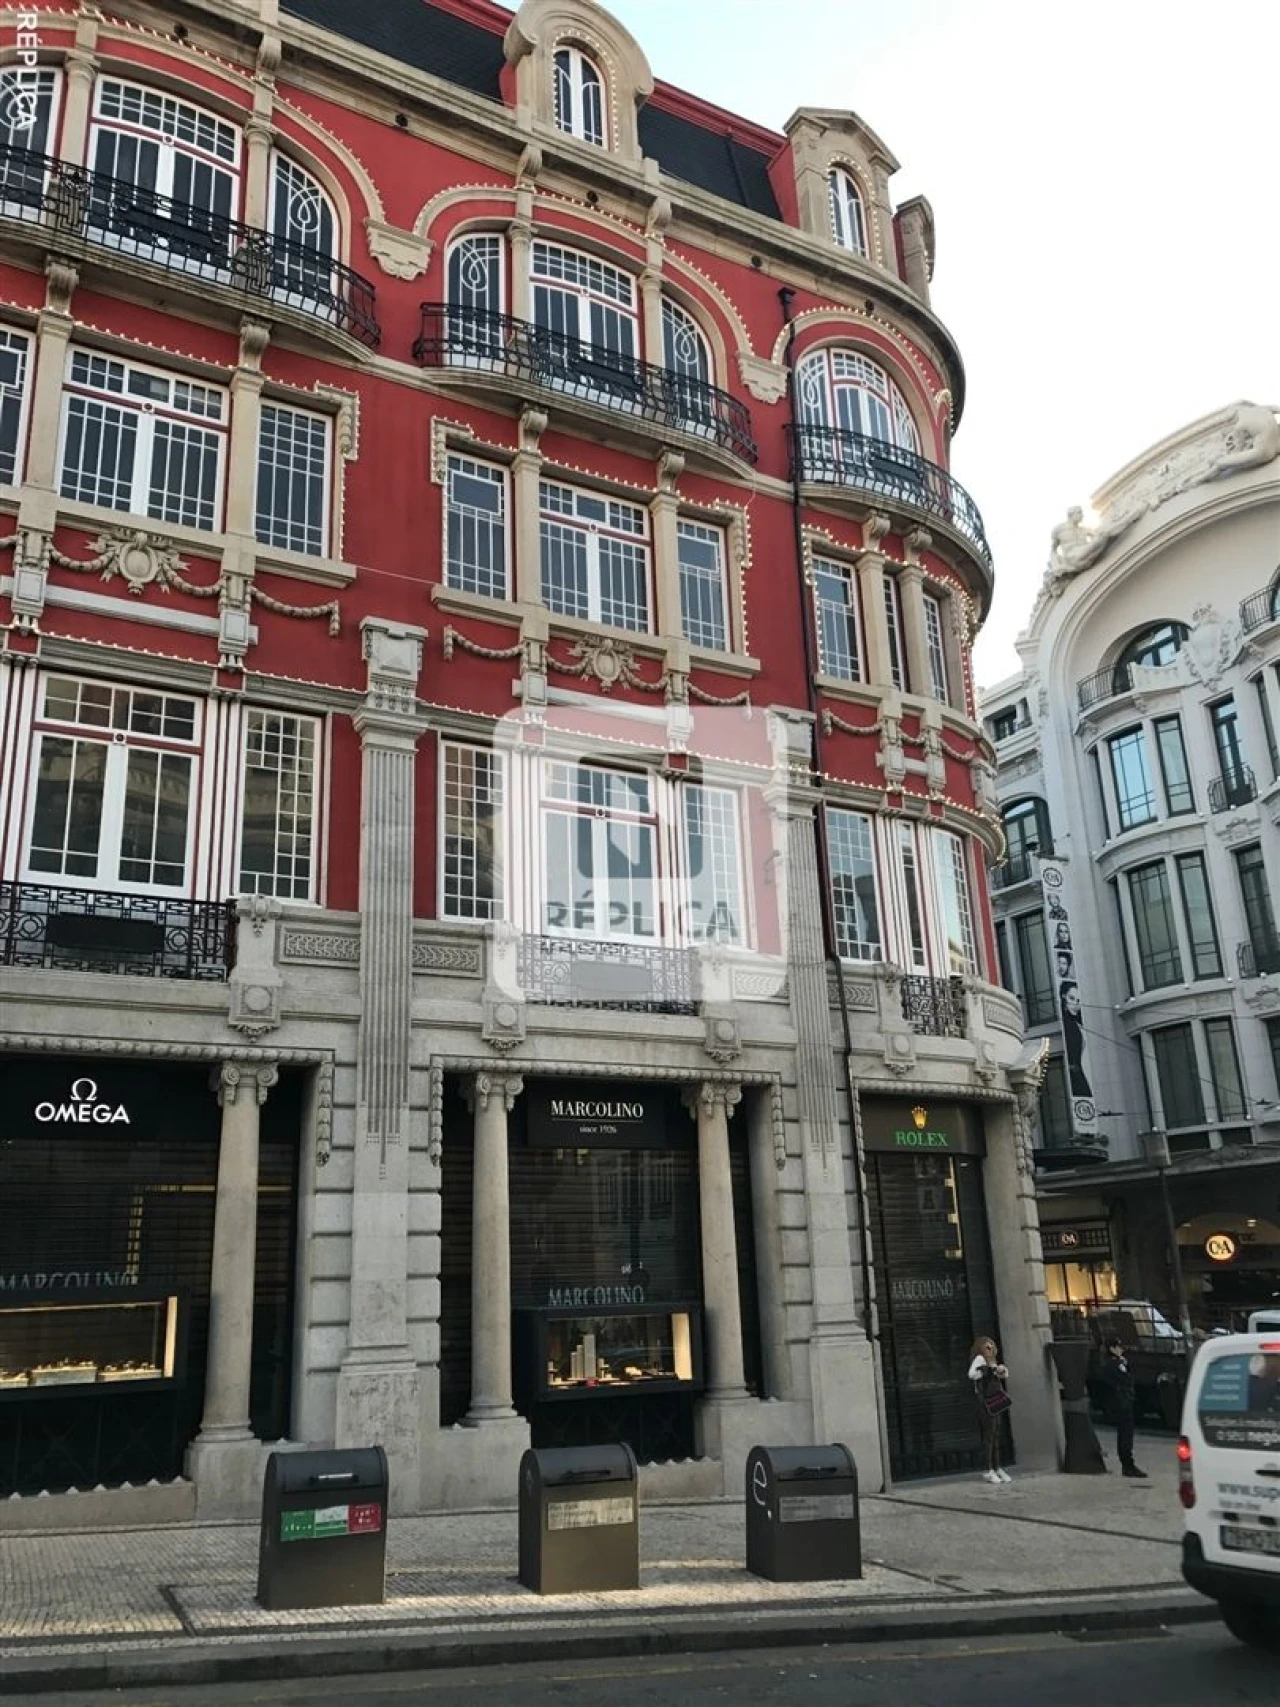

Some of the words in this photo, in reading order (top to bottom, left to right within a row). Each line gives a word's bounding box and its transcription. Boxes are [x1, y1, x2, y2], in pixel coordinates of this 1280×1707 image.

[34, 1101, 131, 1124] OMEGA
[550, 1099, 644, 1118] MARCOLINO
[895, 1131, 949, 1147] ROLEX
